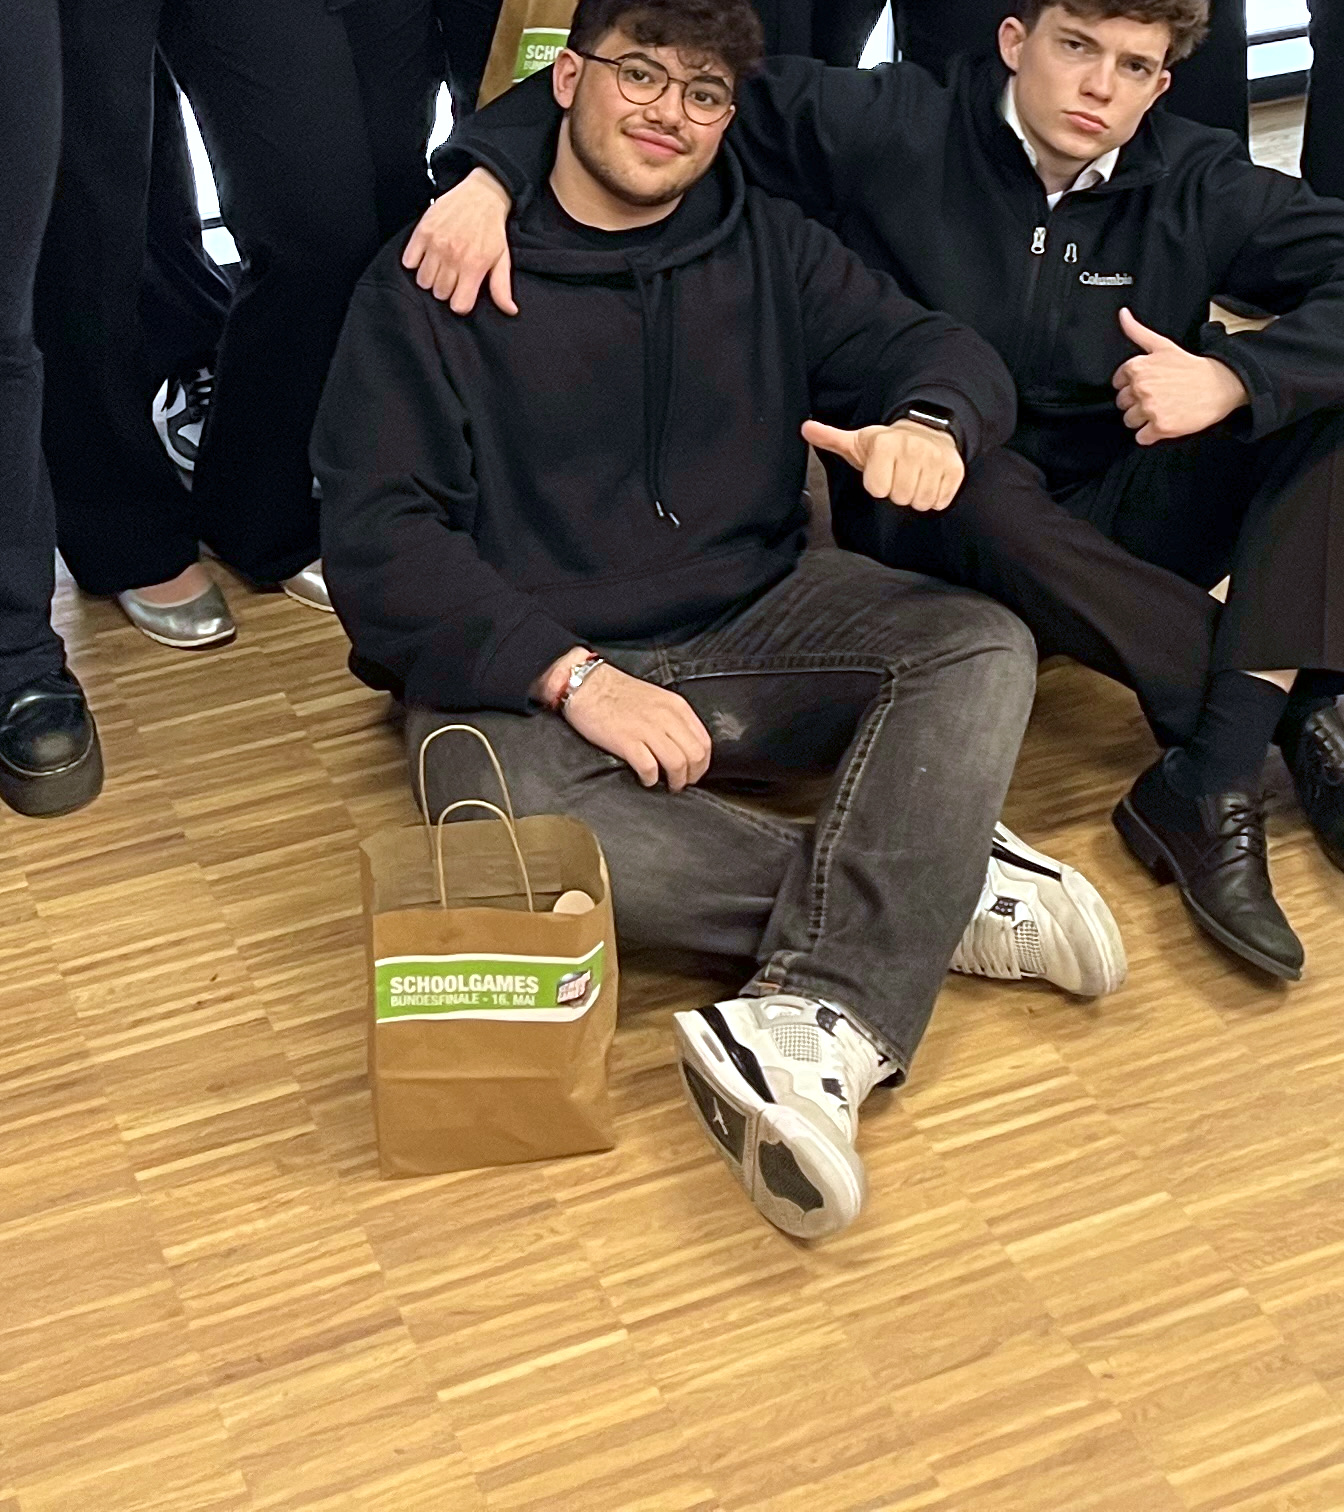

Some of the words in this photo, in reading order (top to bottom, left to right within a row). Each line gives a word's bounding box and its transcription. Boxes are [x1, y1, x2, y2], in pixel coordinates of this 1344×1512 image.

[1079, 271, 1133, 286] Columbia
[390, 974, 539, 994] SCHOOLGAMES
[390, 993, 479, 1007] BUNDESFINALE
[491, 994, 510, 1006] 16.
[513, 995, 536, 1007] MAI
